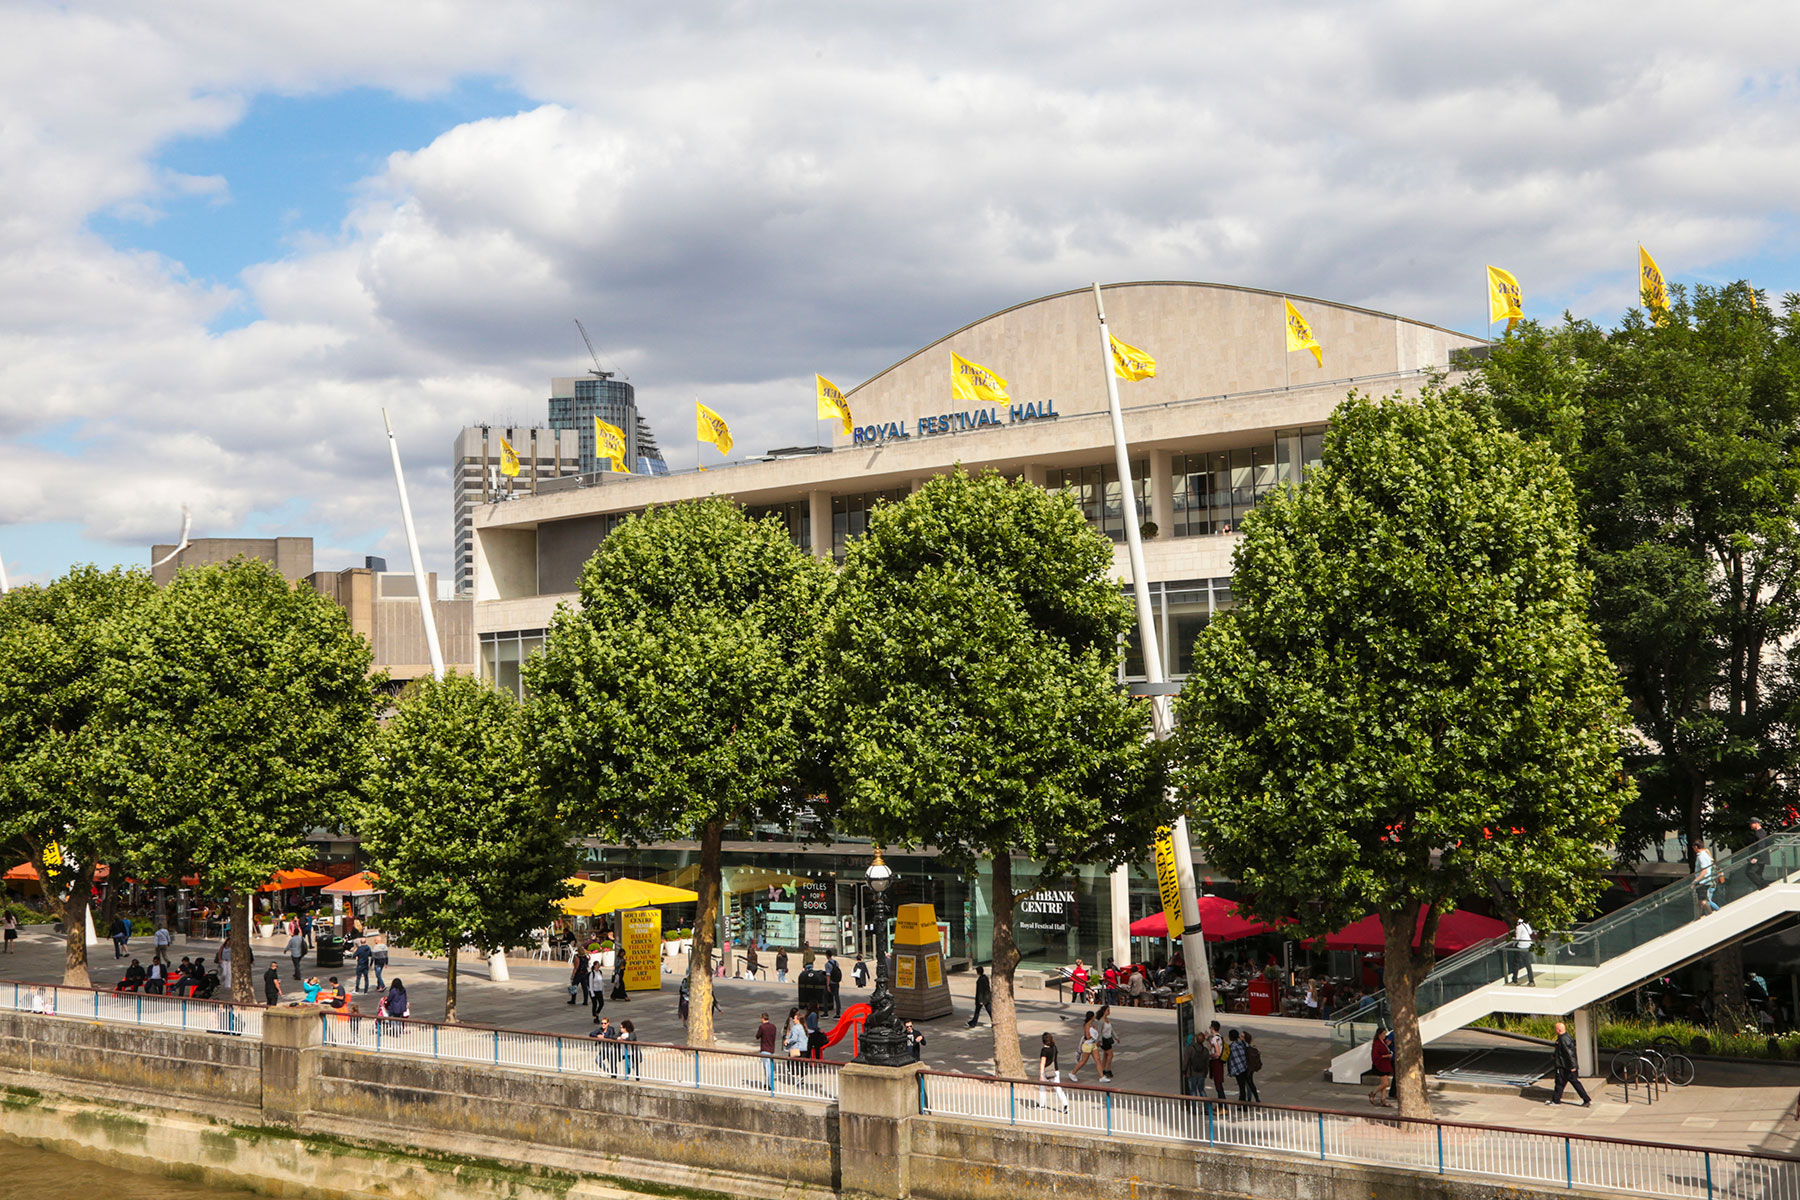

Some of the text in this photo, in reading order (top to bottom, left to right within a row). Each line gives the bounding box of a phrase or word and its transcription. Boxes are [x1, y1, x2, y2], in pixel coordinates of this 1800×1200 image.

[853, 399, 1059, 444] ROYAL FESTIVAL HALL
[841, 856, 873, 867] FOYLE
[1157, 852, 1172, 909] CENTRE
[1164, 840, 1182, 920] OUTHBANK
[802, 883, 827, 891] FOYLES
[803, 901, 827, 910] BOOKS
[1020, 901, 1064, 914] CENTRE
[1020, 921, 1034, 930] Royal
[1035, 922, 1053, 930] Festival
